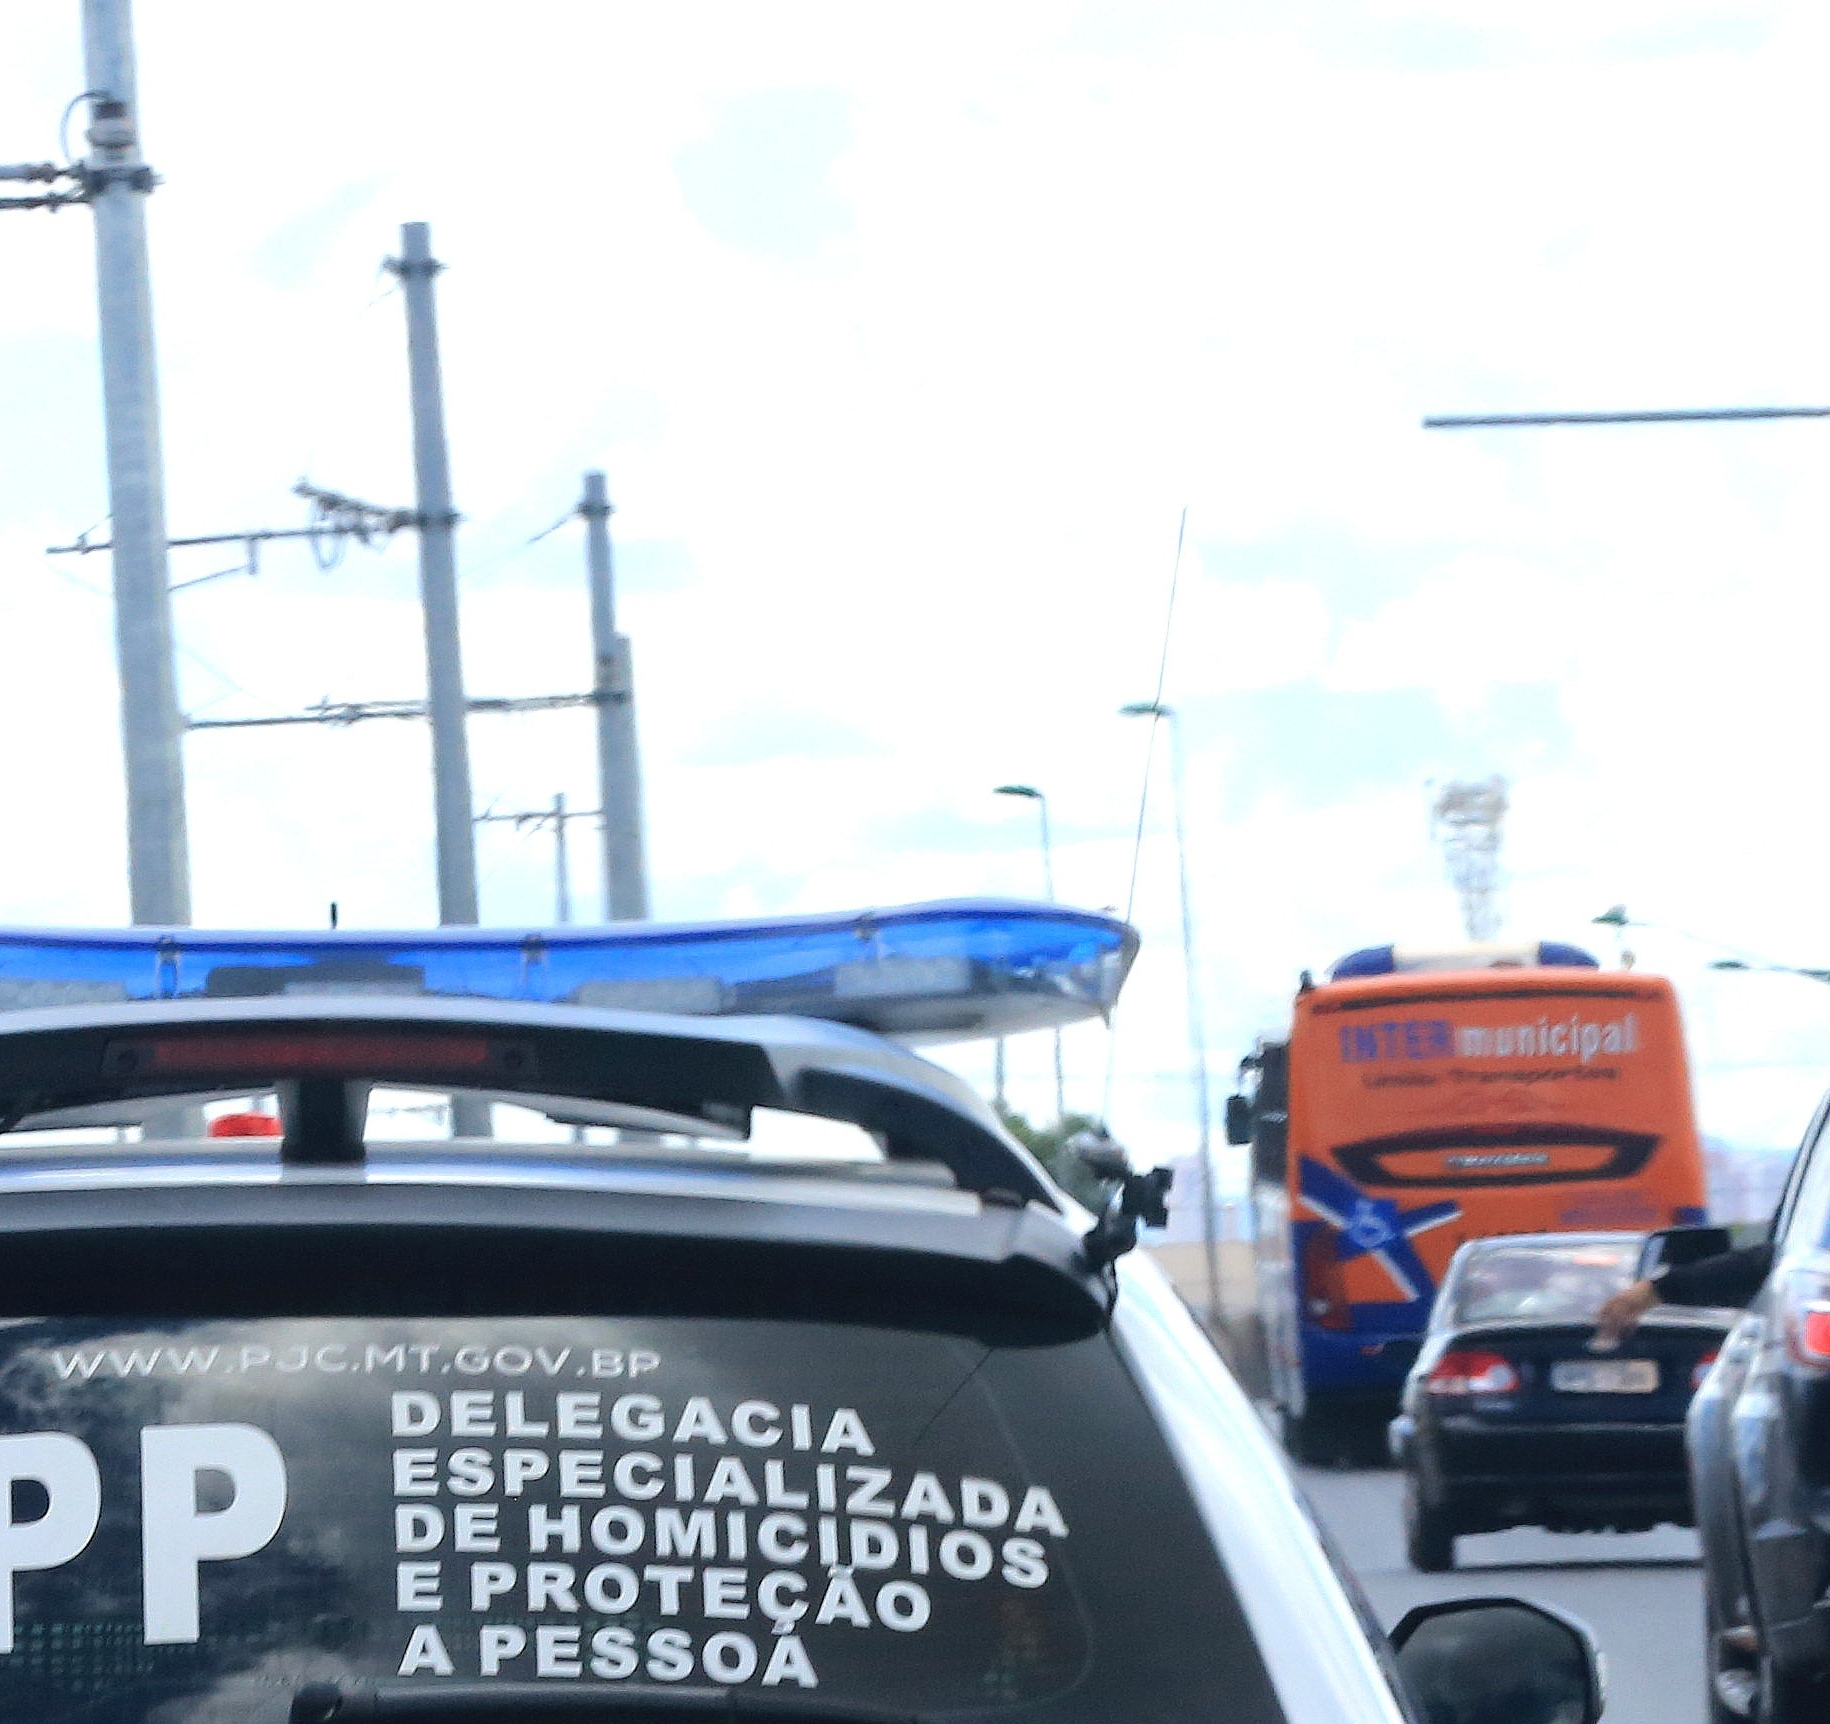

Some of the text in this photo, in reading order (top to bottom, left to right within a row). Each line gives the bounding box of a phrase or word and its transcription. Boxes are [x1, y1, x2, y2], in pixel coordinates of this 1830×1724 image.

[390, 1389, 875, 1456] DELEGACIA
[391, 1447, 1069, 1538] ESPECIALIZADA
[394, 1502, 501, 1554] DE
[396, 1560, 932, 1636] E PROTEÇÃO
[397, 1624, 456, 1677] A
